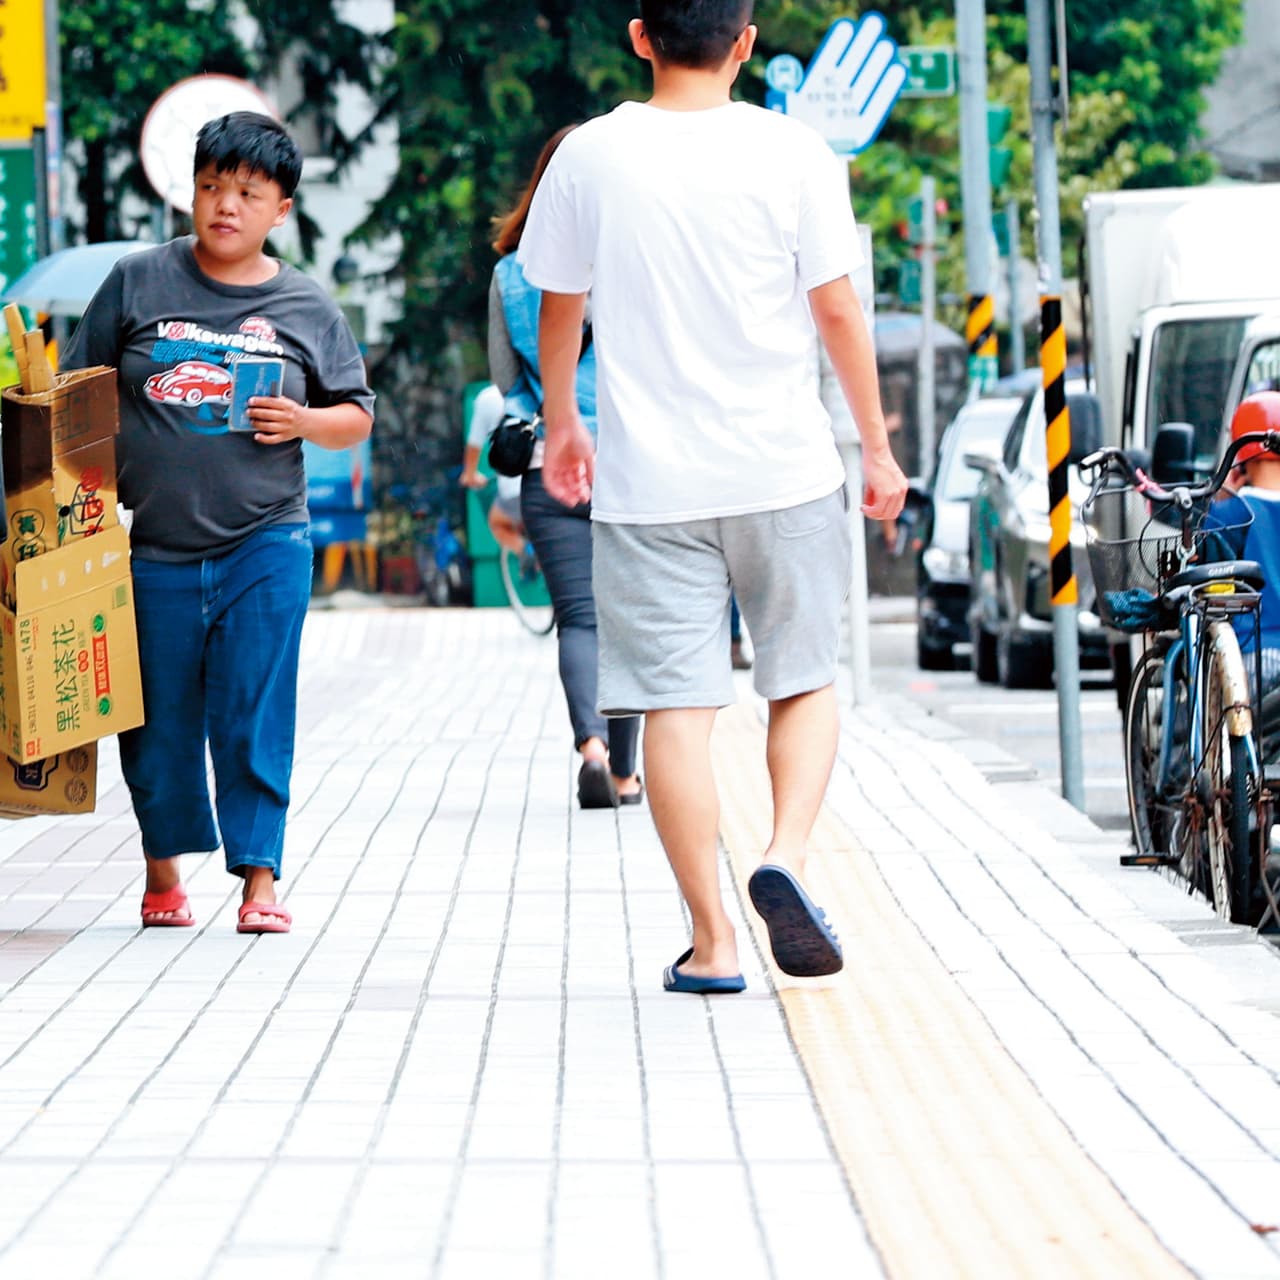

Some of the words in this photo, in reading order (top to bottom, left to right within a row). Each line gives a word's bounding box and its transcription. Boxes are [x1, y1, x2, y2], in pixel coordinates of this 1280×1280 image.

[20, 619, 31, 652] 1478
[51, 618, 81, 733] 黑松茶花
